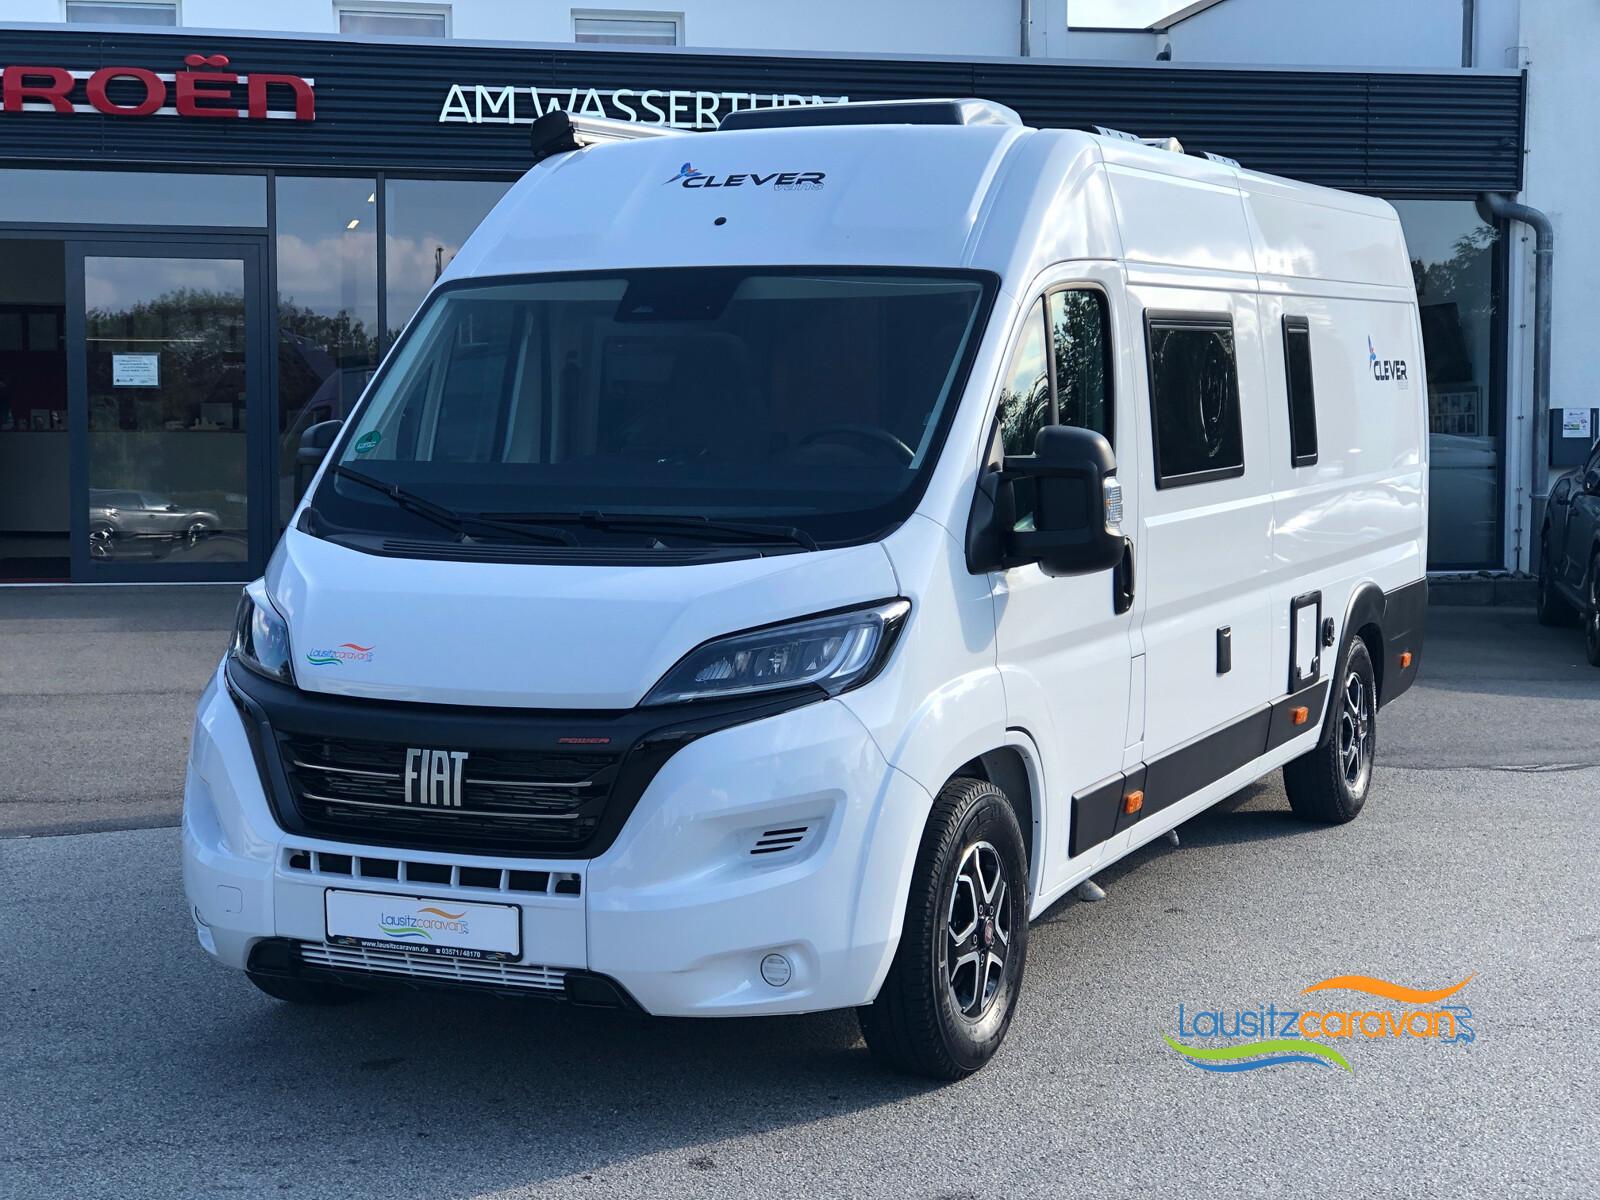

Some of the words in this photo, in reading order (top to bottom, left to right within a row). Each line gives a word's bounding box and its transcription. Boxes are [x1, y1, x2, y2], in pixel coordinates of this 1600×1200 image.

[439, 84, 515, 124] AM
[530, 87, 849, 129] WASSERT
[682, 171, 826, 189] CLEVER
[1373, 360, 1408, 381] CLEVER
[404, 748, 469, 807] FIAT
[381, 912, 464, 934] Lausitzcaravan
[361, 940, 429, 953] www.lausitzcaravan.de
